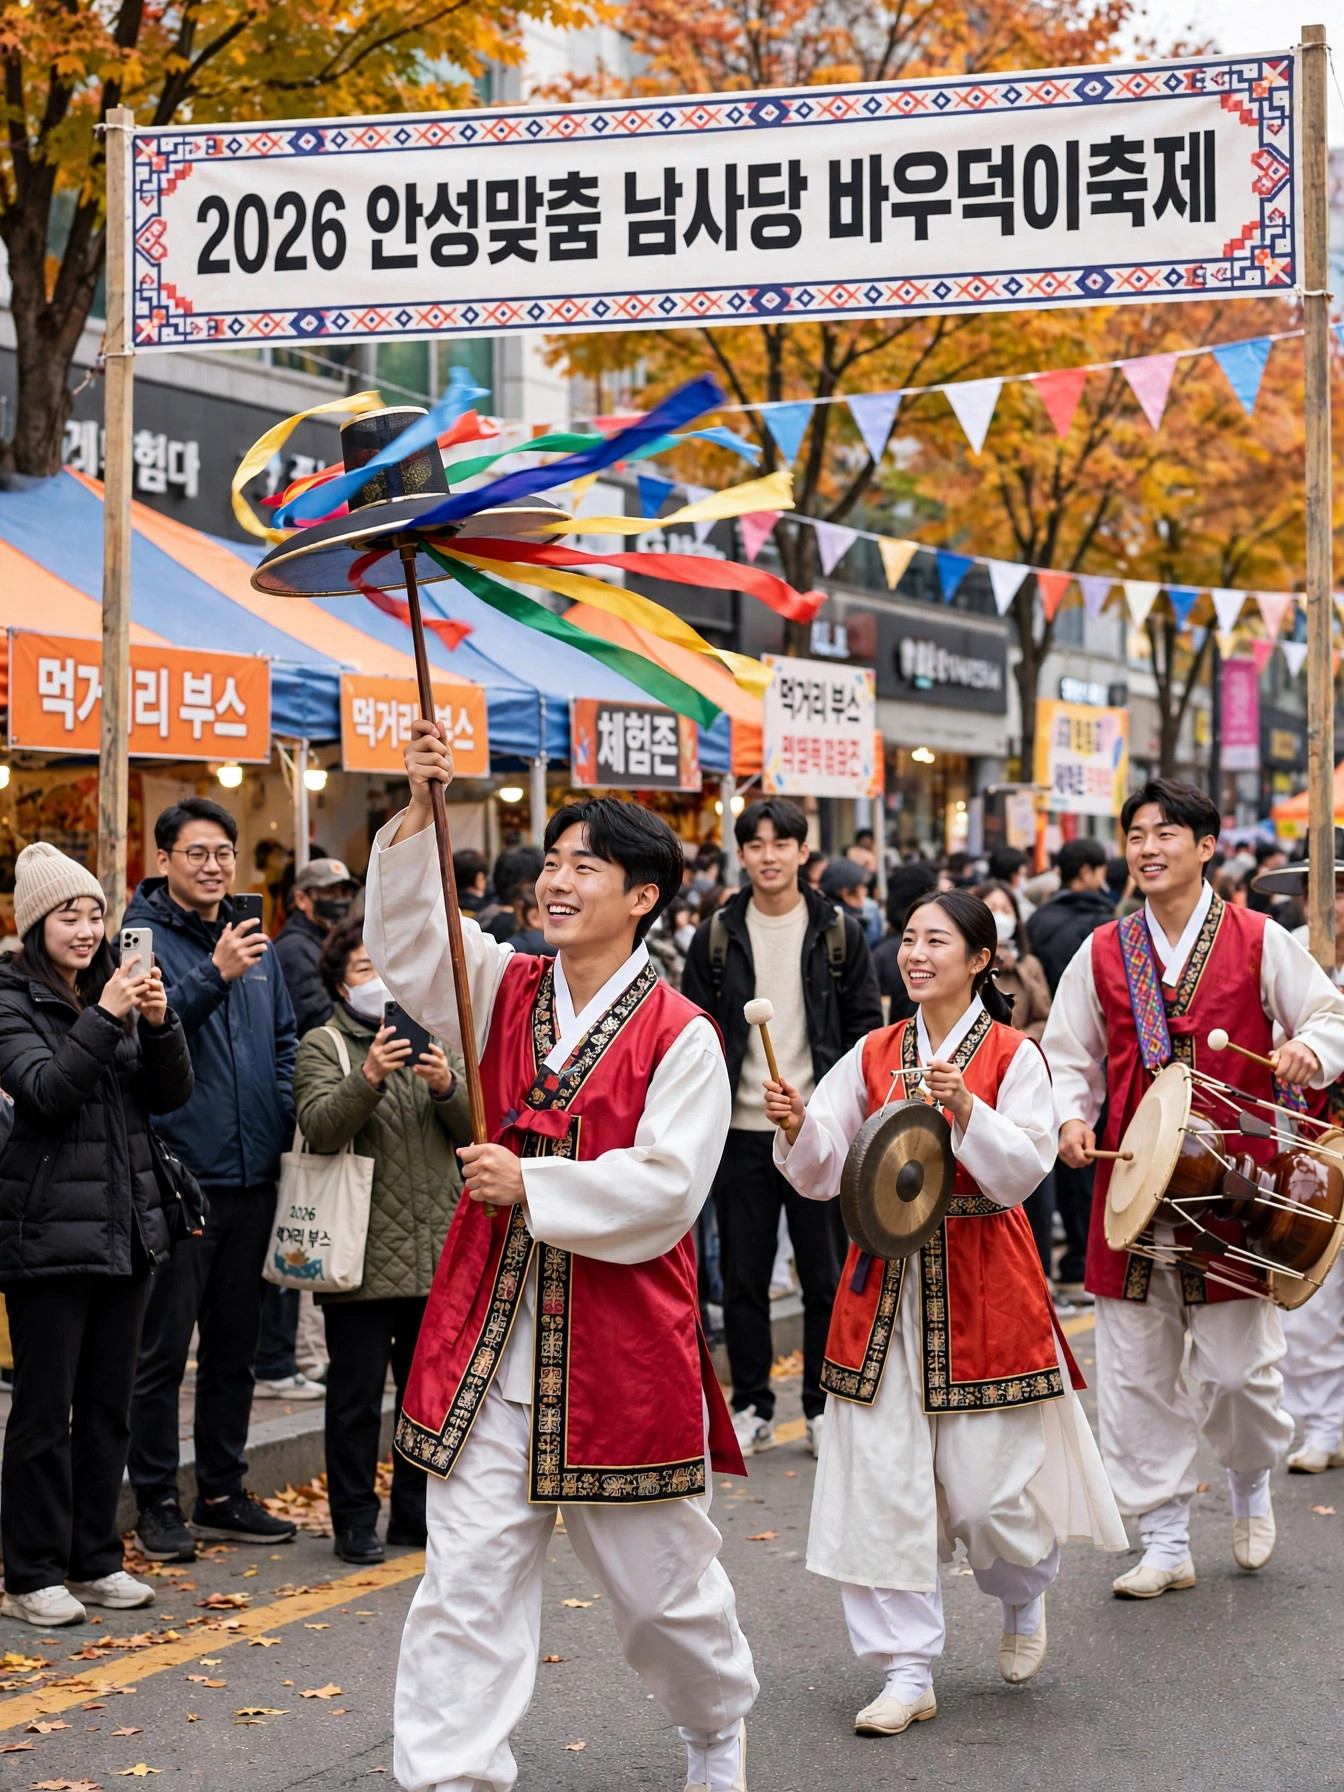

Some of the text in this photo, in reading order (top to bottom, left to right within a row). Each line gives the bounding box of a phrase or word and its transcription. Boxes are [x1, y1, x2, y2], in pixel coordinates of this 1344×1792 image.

[197, 129, 1217, 275] 2026 안성맞춤 남사당 바우덕이축제
[38, 657, 248, 740] 먹거리 부스
[352, 697, 419, 749] 먹거리
[781, 677, 860, 723] 먹거리 부스
[598, 711, 678, 777] 체험존
[290, 1205, 316, 1221] 2026
[309, 1229, 331, 1248] 부스
